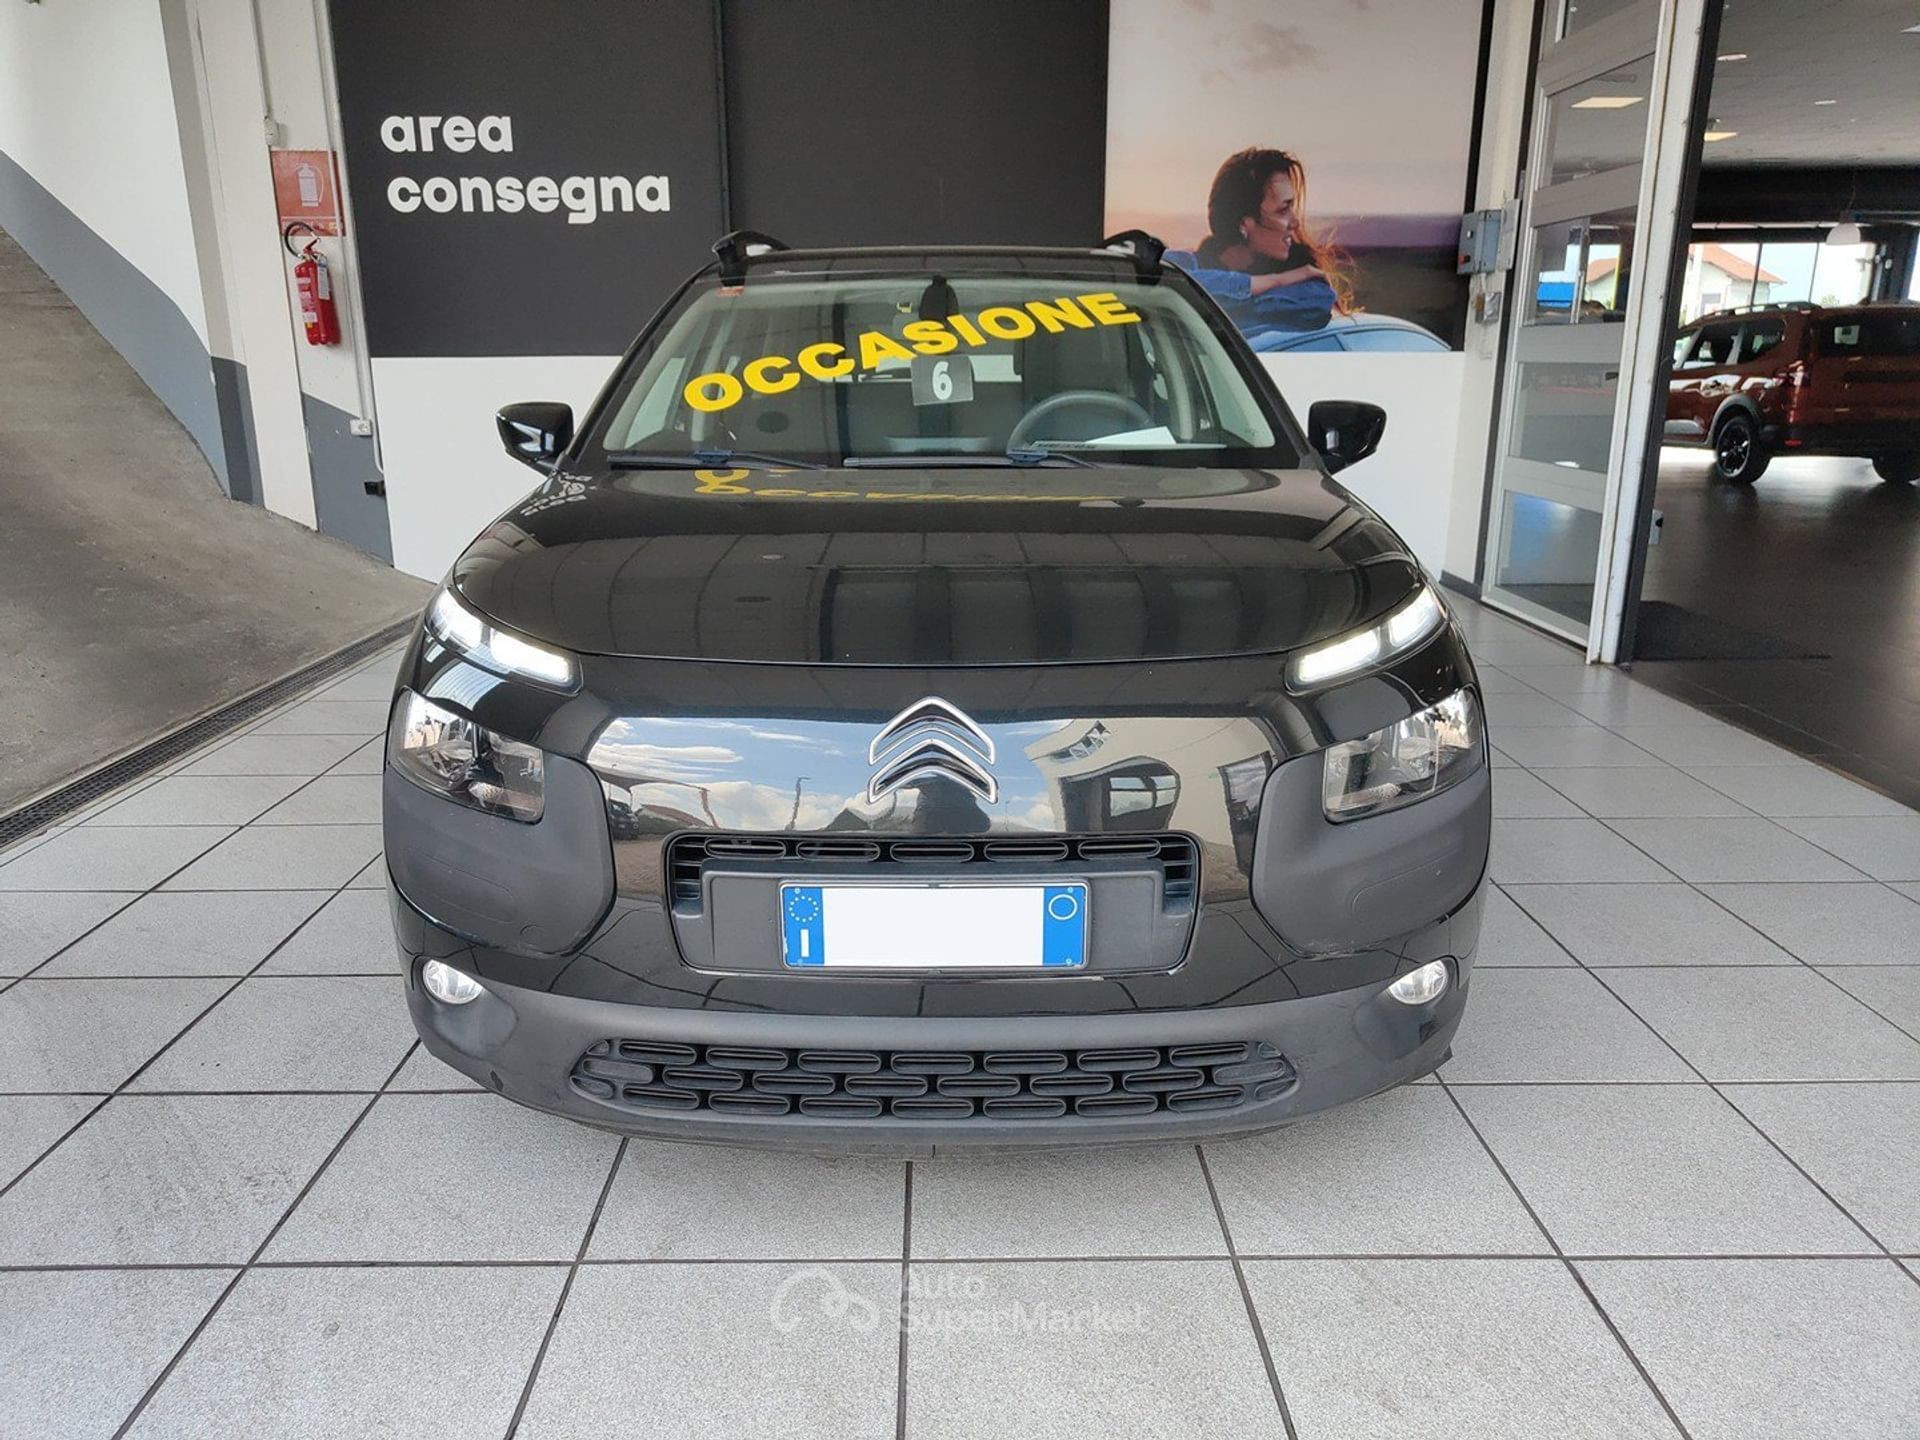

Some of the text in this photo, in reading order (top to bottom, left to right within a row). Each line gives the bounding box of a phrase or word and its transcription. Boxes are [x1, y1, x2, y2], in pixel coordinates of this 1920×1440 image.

[381, 115, 513, 153] area
[388, 175, 670, 225] consegna
[683, 293, 1140, 412] OCCASIONE
[932, 361, 953, 400] 6
[800, 928, 810, 958] I
